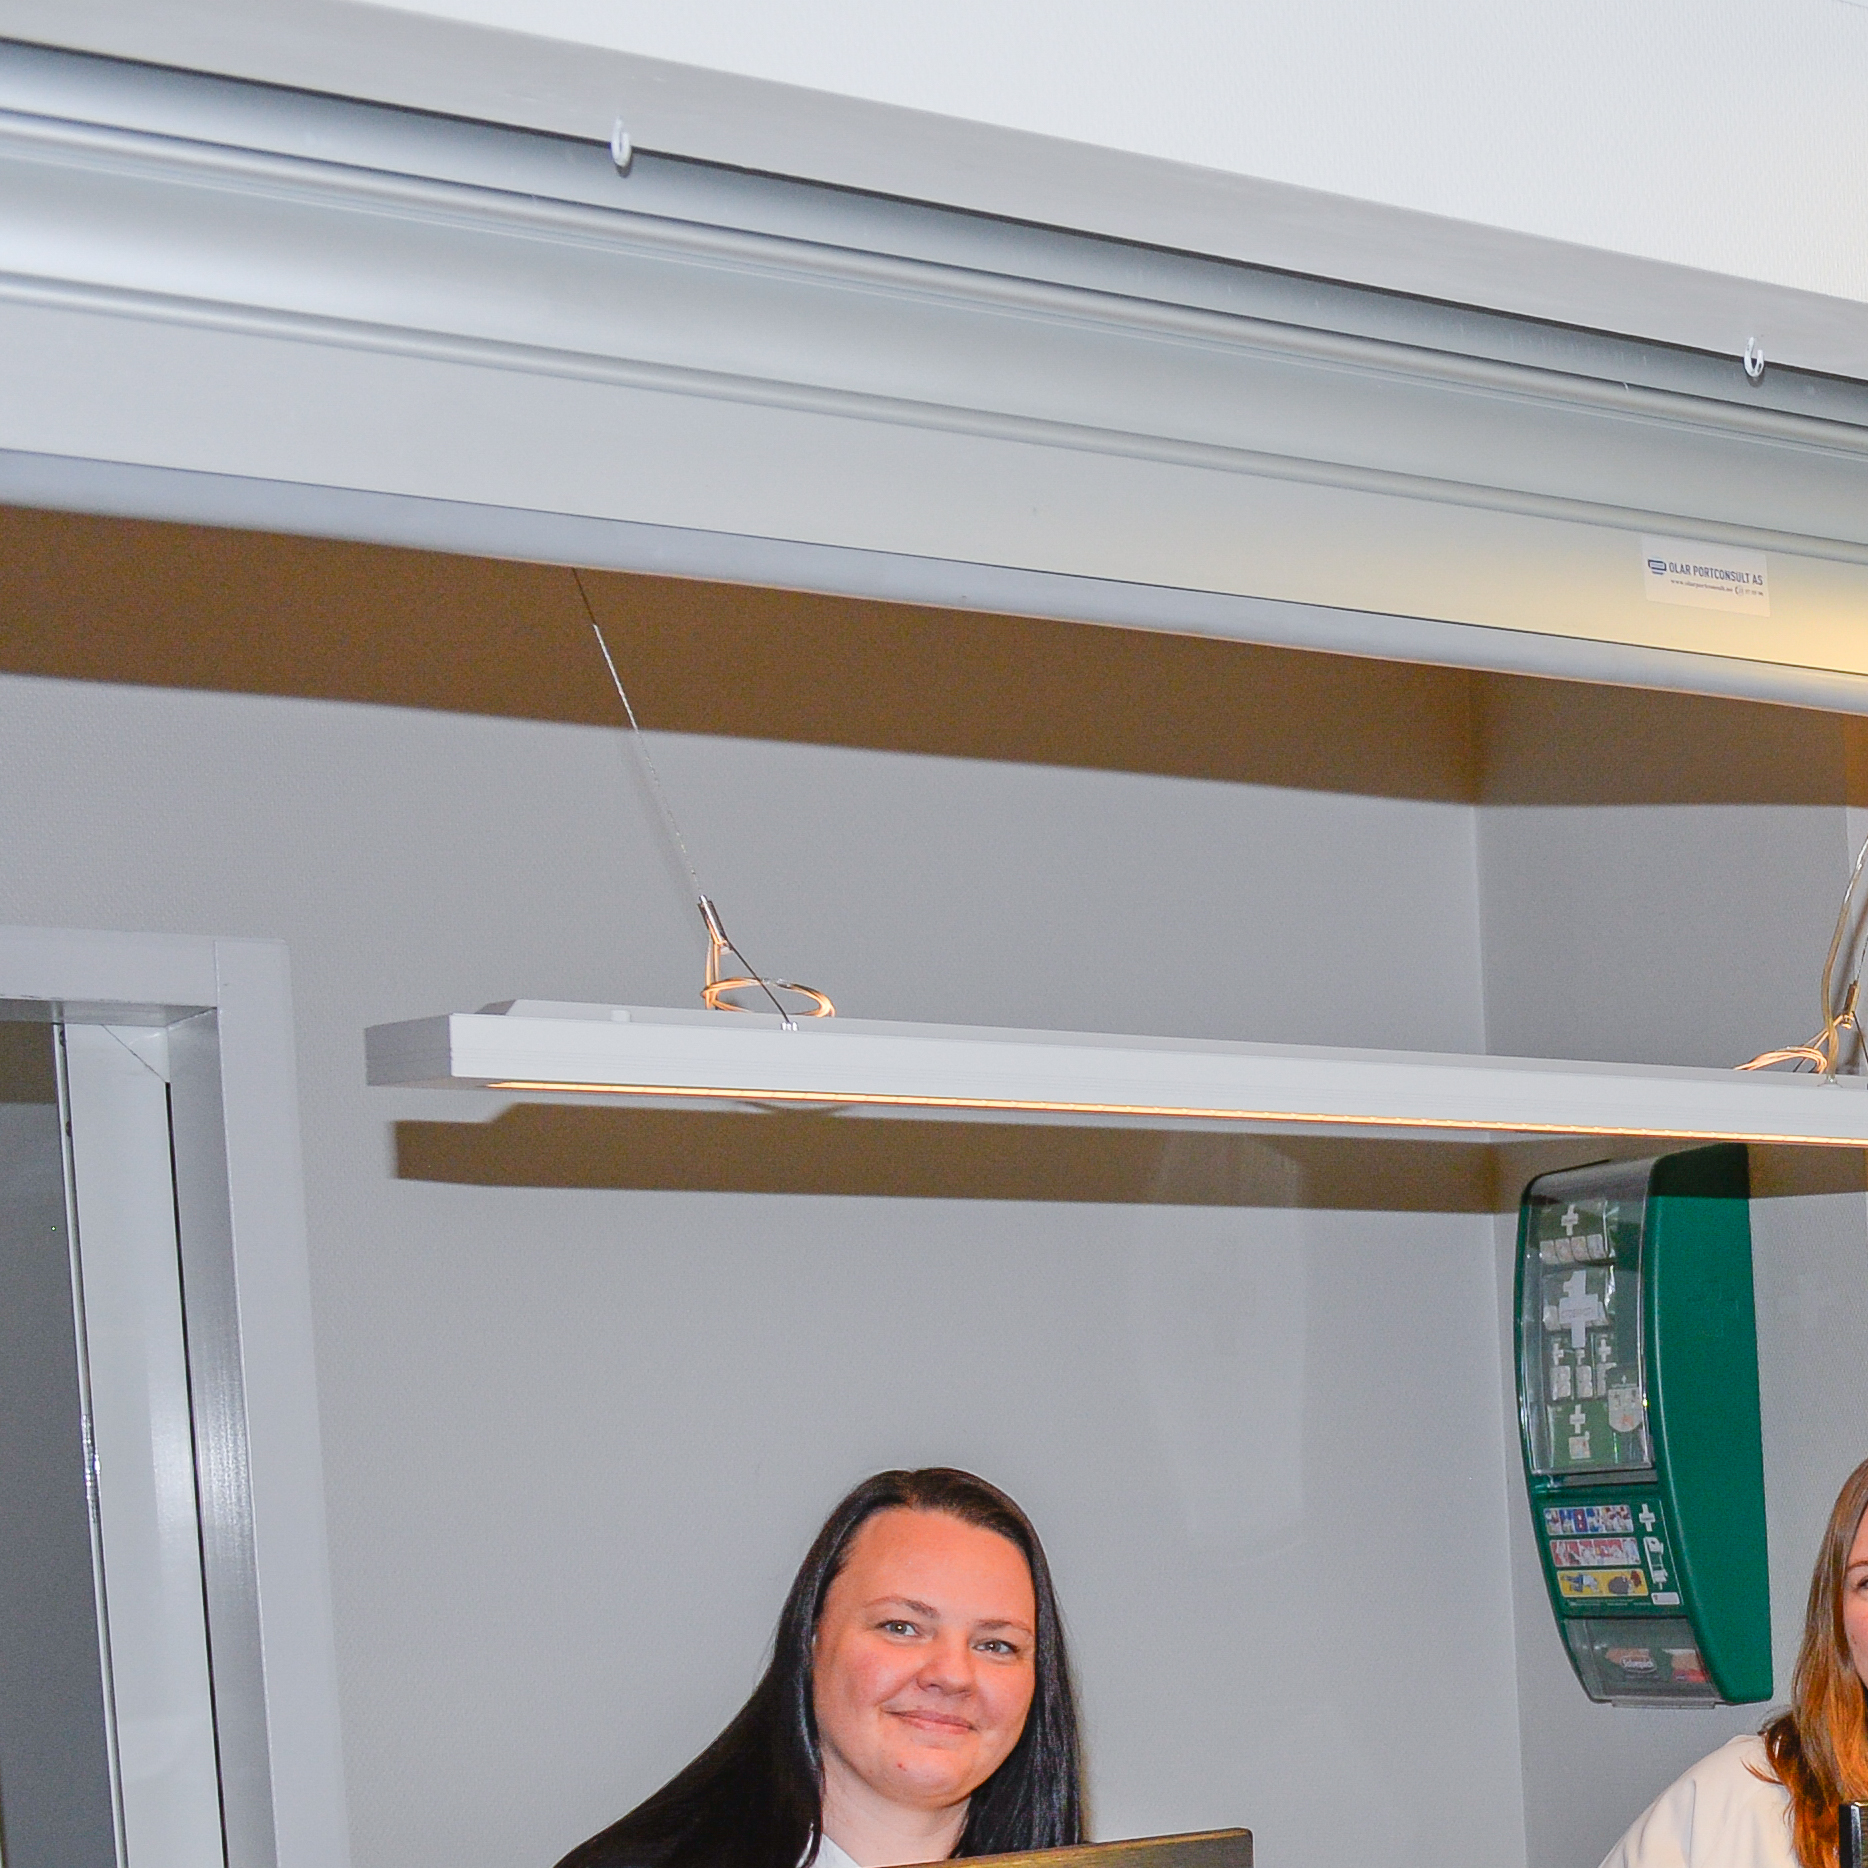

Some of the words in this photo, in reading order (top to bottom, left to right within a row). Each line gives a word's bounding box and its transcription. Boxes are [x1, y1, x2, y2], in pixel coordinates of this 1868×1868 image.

[1669, 562, 1691, 575] OLAR
[1693, 565, 1750, 584] PORTCONSULT
[1752, 574, 1763, 585] AS
